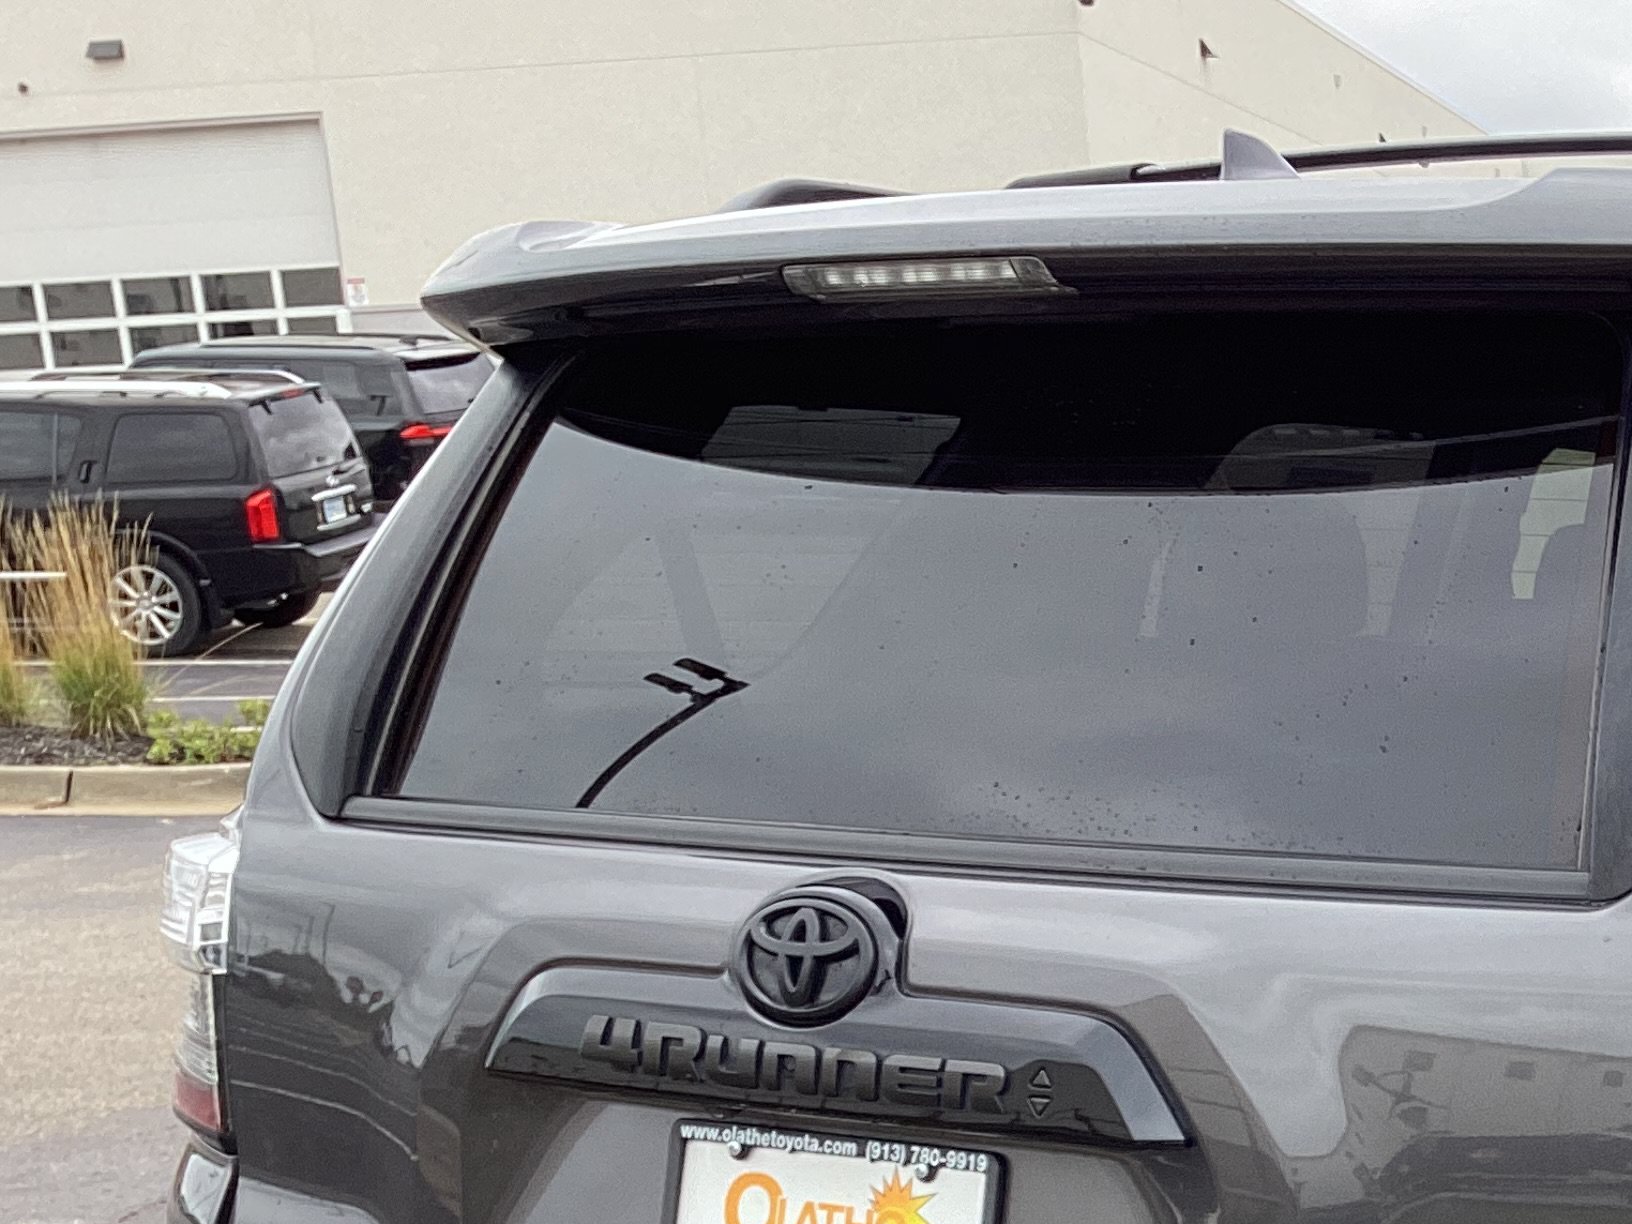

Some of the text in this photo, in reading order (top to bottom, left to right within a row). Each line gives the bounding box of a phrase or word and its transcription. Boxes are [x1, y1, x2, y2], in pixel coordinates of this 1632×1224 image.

[582, 1015, 1008, 1112] 4RUNNER
[680, 1125, 988, 1171] www.olathetoyota.com (913) 780-9919
